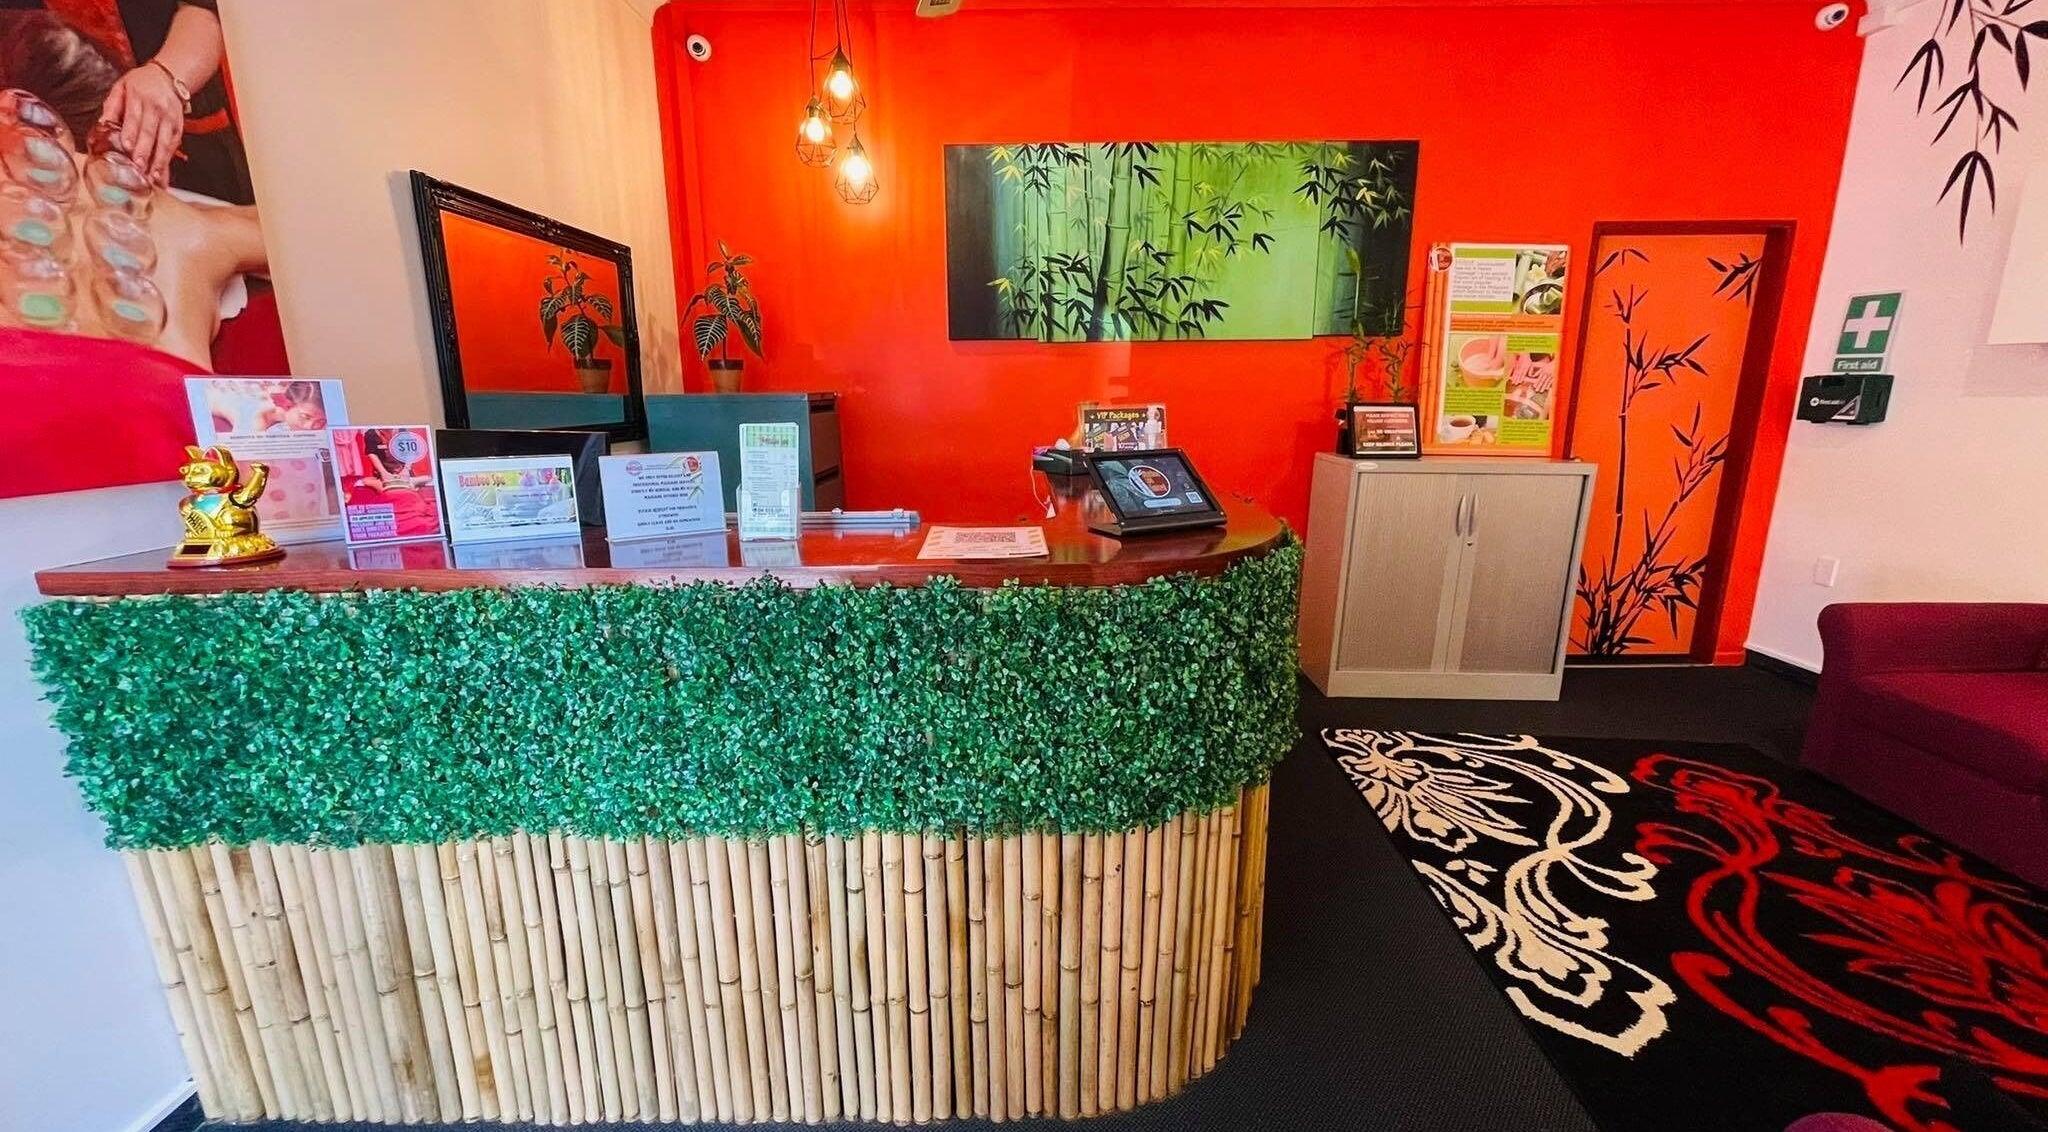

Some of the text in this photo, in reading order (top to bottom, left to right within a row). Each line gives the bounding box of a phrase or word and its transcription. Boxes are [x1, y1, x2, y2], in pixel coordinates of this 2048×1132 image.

[1837, 359, 1879, 370] First aid
[1097, 411, 1140, 421] VIP Packages
[398, 441, 417, 452] $10
[459, 473, 506, 487] Bamboo Spa
